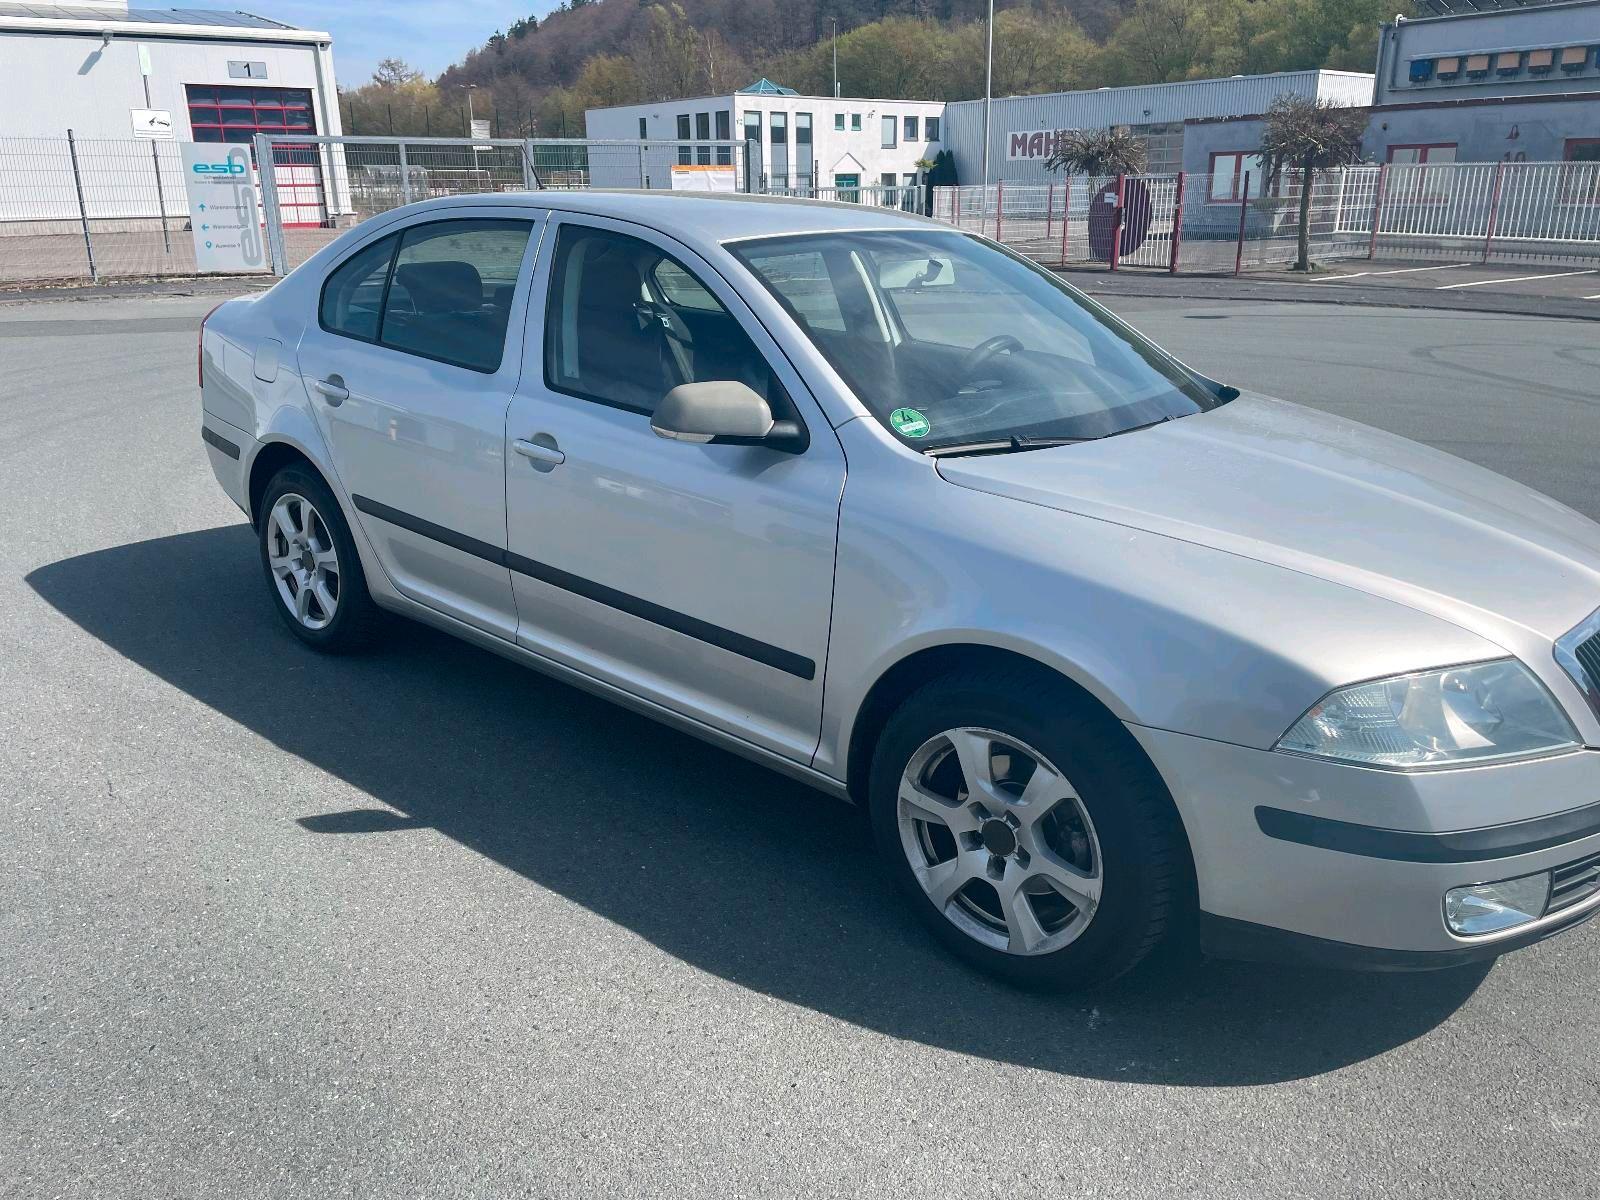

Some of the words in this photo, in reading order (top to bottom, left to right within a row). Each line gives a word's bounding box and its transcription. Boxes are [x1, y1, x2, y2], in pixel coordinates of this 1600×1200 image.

[244, 63, 251, 77] 1
[1011, 131, 1064, 159] MAH
[193, 155, 245, 174] esb
[900, 411, 914, 423] 4
